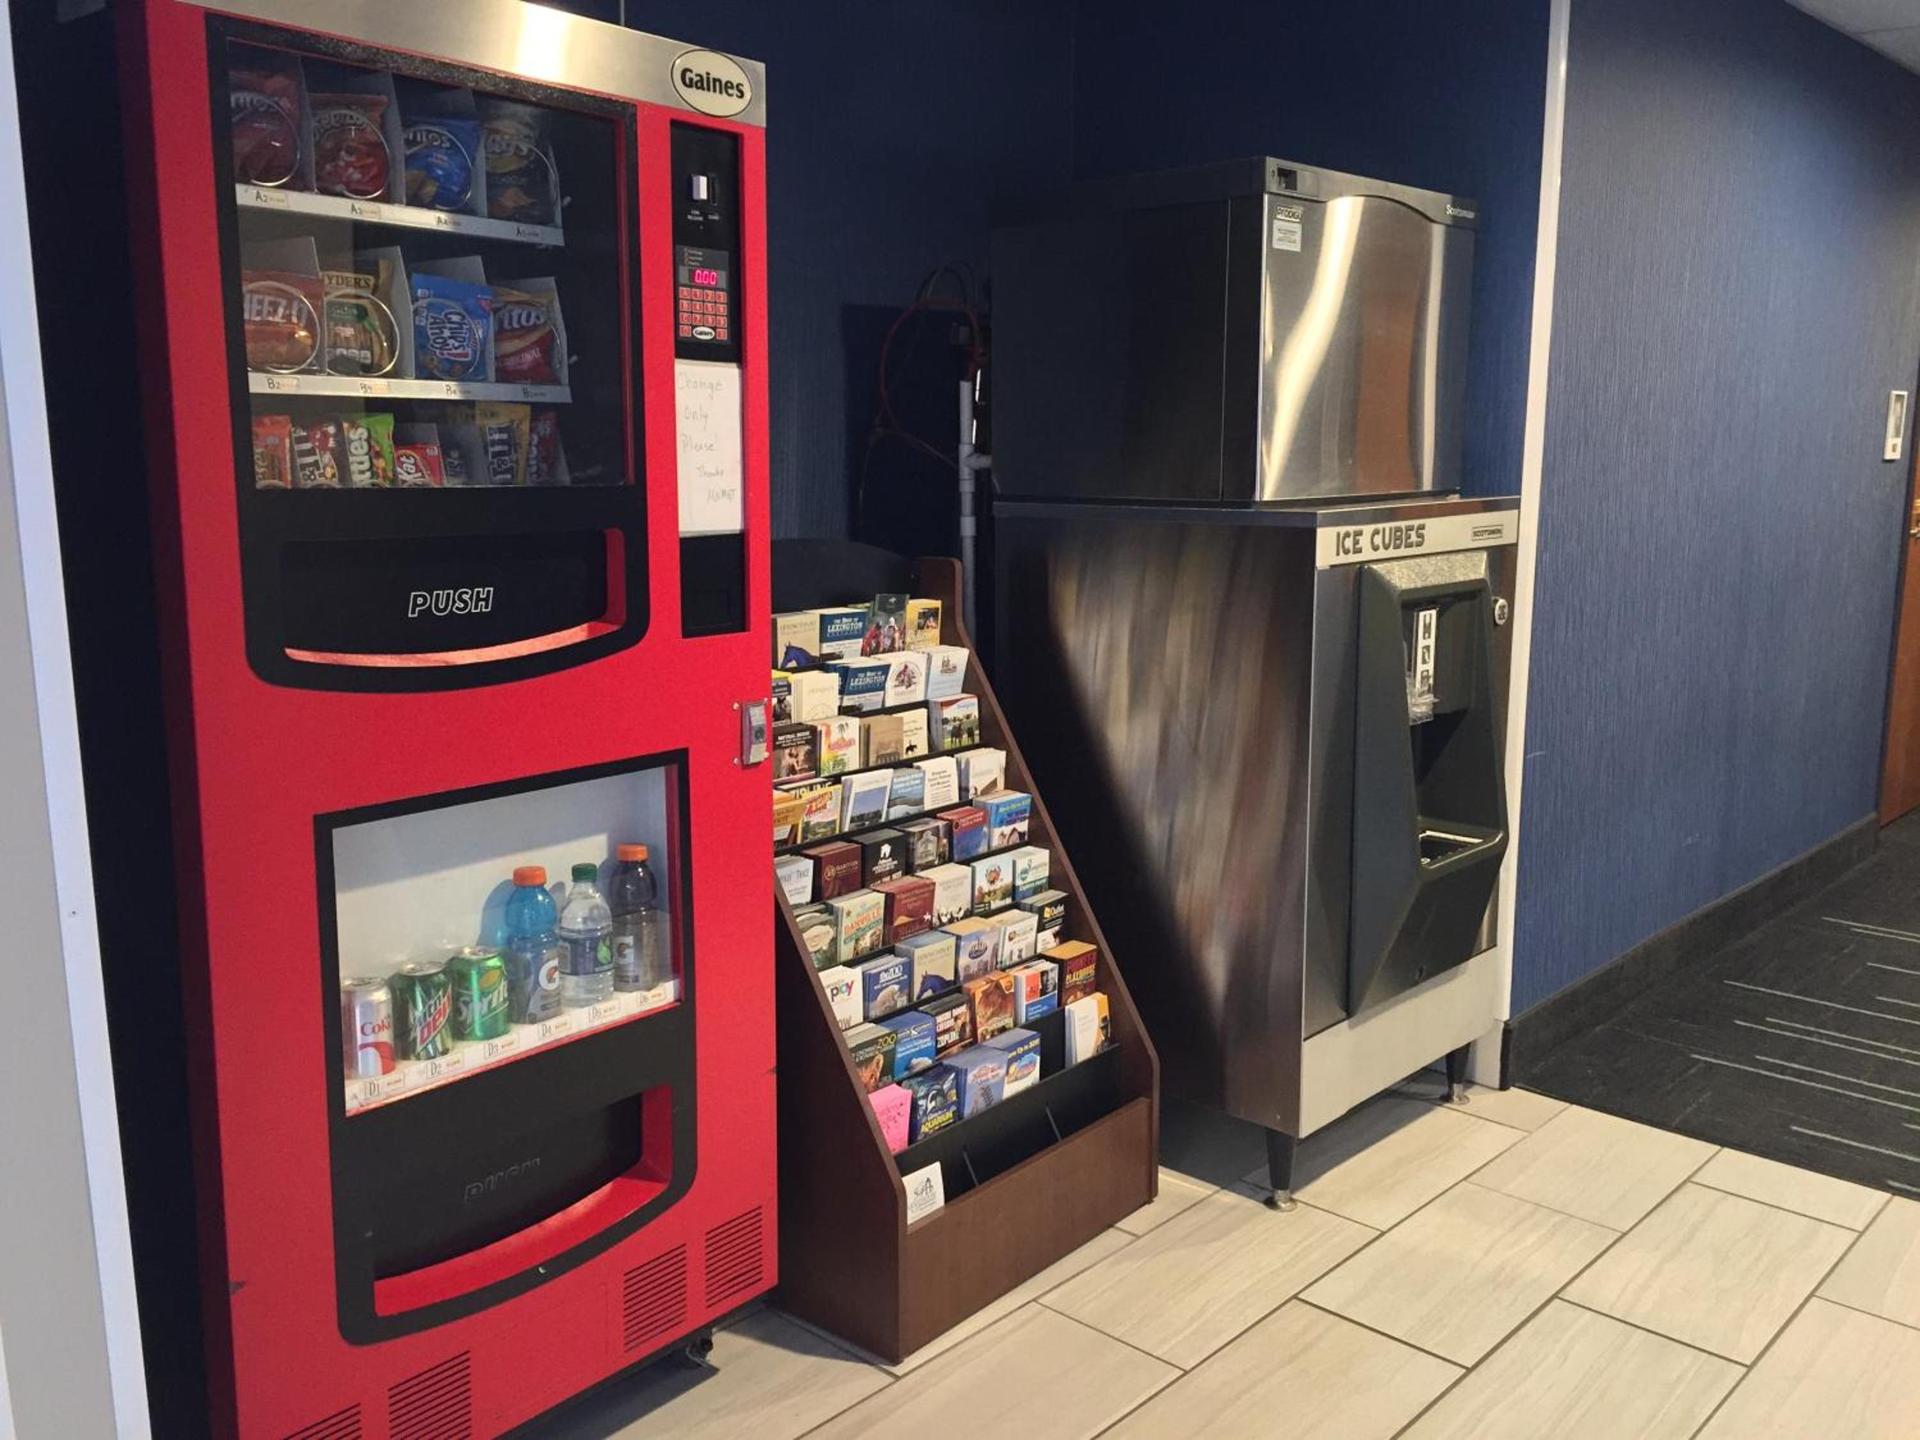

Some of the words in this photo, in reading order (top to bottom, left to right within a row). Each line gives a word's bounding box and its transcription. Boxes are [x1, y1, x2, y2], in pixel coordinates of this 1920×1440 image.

[680, 68, 745, 99] Gaines
[1336, 529, 1363, 556] ICE
[1371, 523, 1426, 551] CUBES
[408, 587, 494, 618] PUSH
[827, 621, 863, 633] LEXINGTON
[850, 674, 885, 686] LEXINGTON
